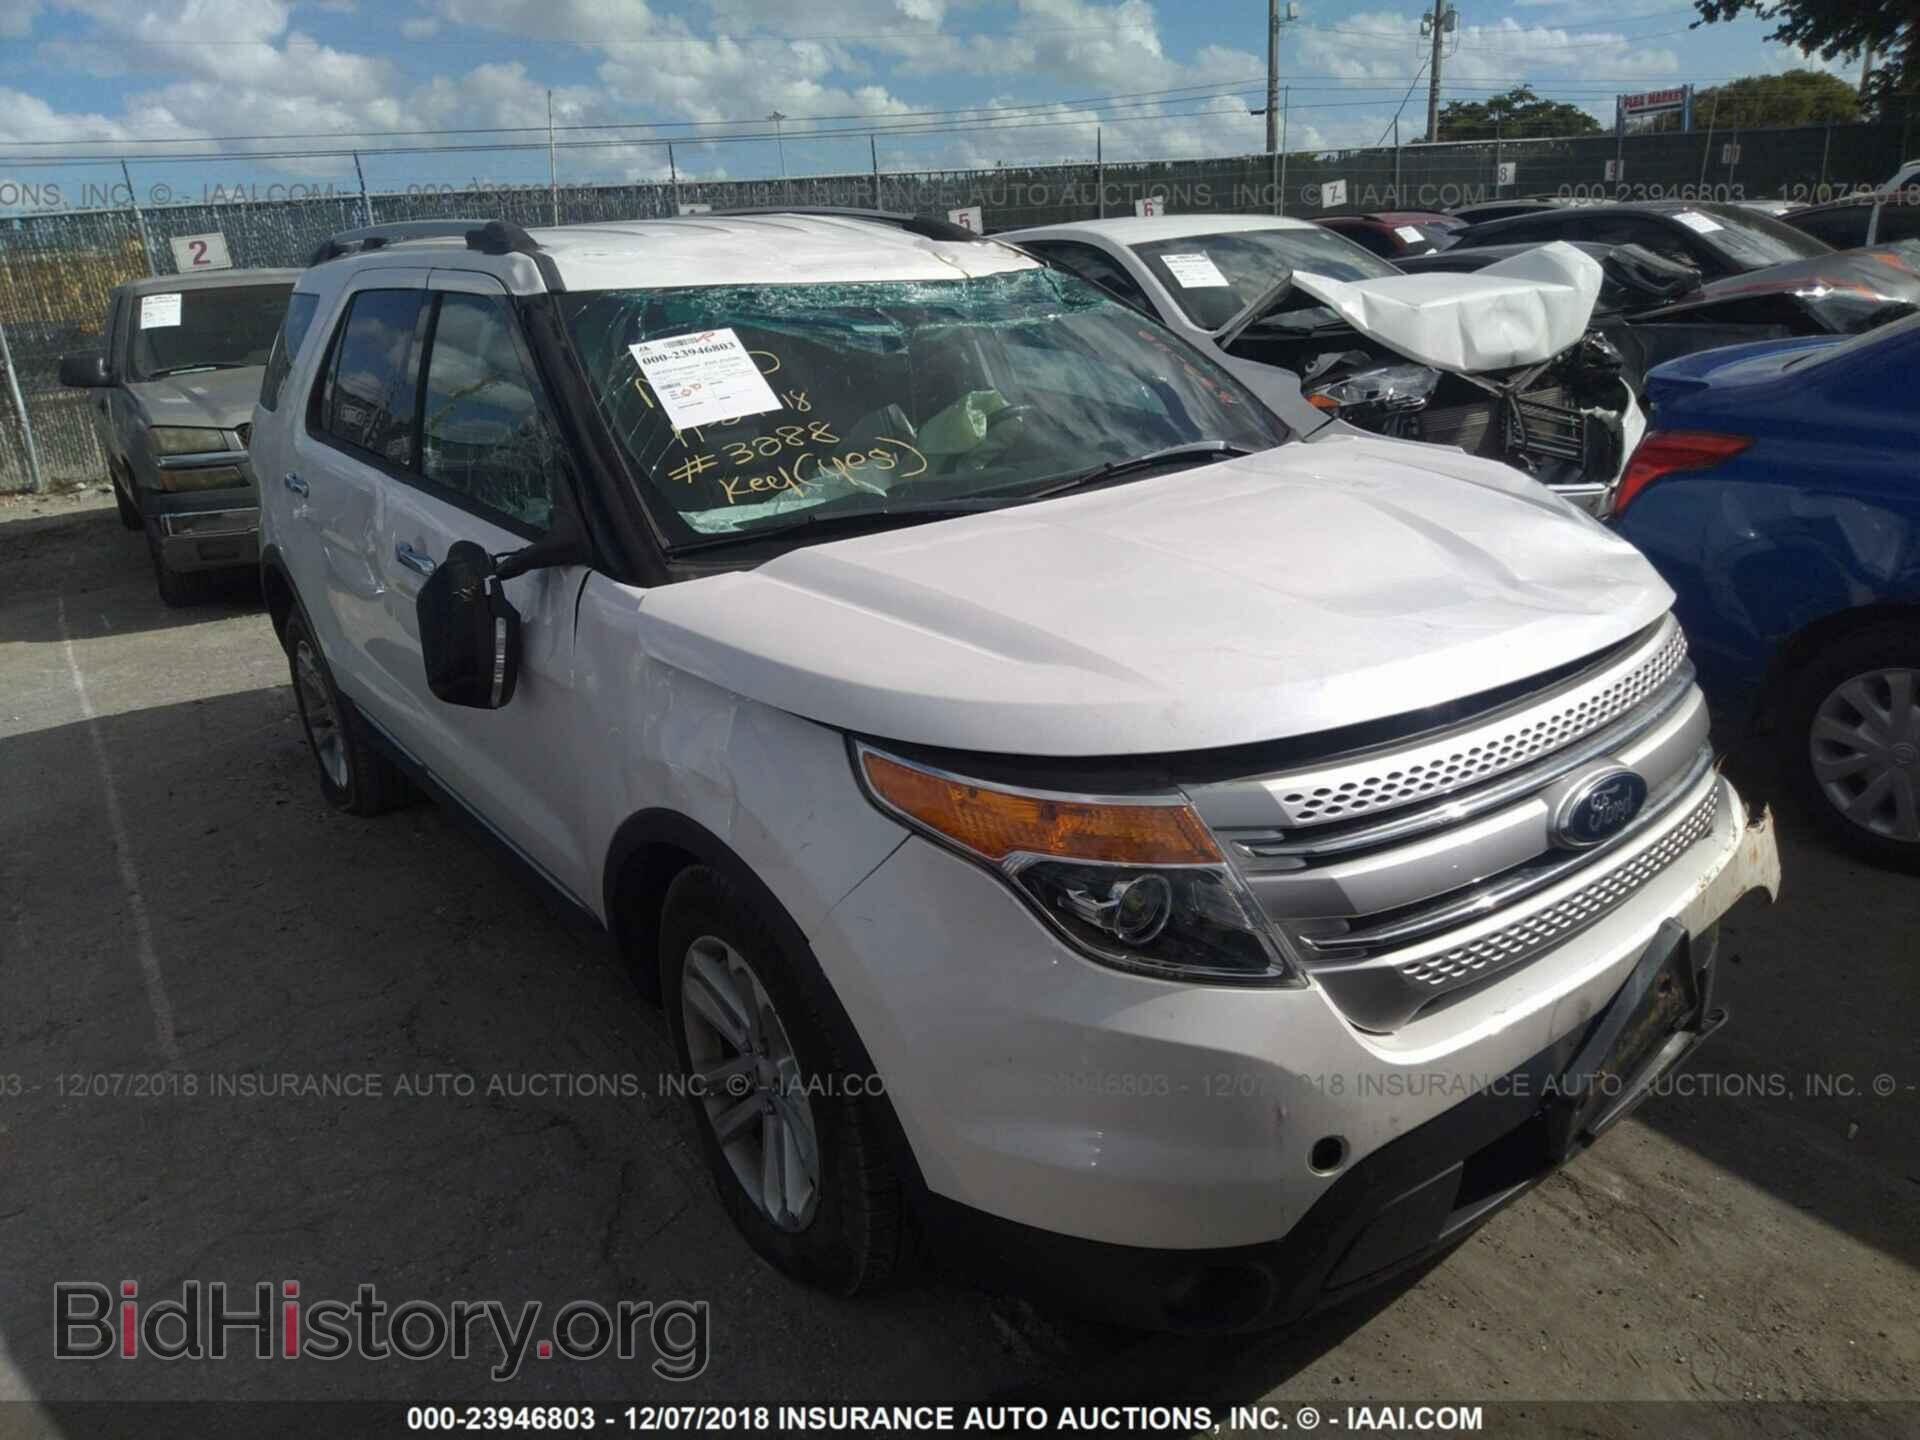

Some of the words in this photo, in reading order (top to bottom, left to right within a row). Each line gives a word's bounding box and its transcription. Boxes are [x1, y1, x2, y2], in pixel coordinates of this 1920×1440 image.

[1499, 166, 1508, 183] 8
[1143, 200, 1154, 217] 6
[957, 211, 971, 230] 5
[188, 240, 211, 265] 2
[642, 341, 737, 366] 000-23946803
[1589, 783, 1633, 832] Ford
